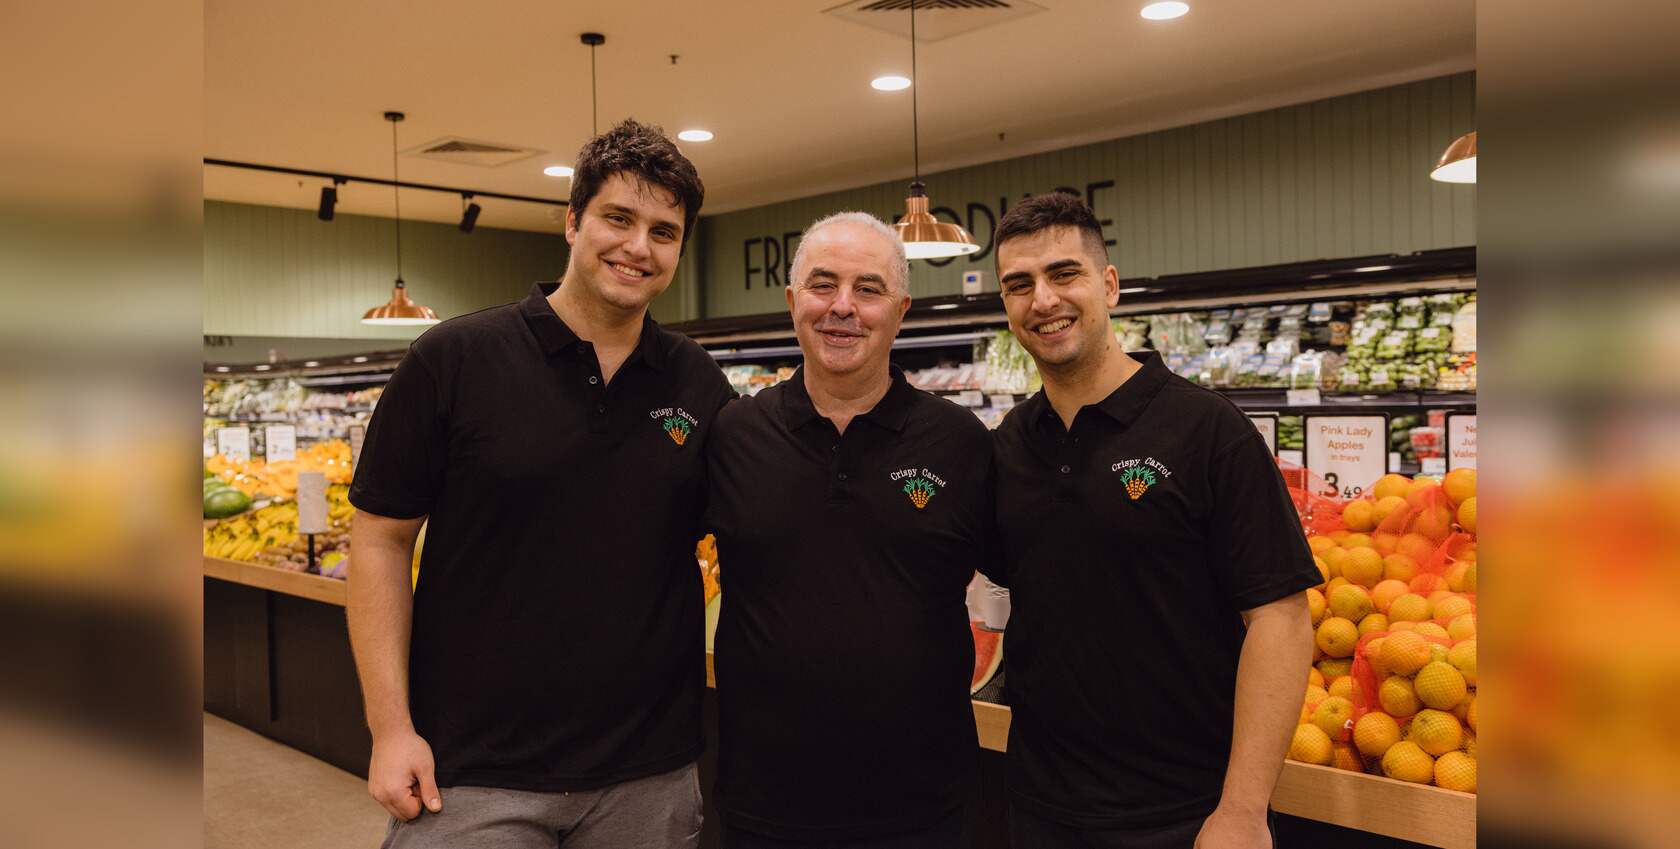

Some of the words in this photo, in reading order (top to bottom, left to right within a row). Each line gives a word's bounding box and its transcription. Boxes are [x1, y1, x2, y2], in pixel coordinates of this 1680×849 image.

[744, 230, 802, 290] FRE
[649, 407, 674, 419] Crispy
[677, 407, 699, 427] Carrot
[1320, 425, 1343, 434] Pink
[1346, 426, 1374, 438] Lady
[1327, 440, 1365, 450] Apples
[1111, 458, 1141, 472] Crispy
[1144, 456, 1172, 478] Carrot
[890, 468, 918, 481] Crispy
[922, 468, 947, 488] Carrot
